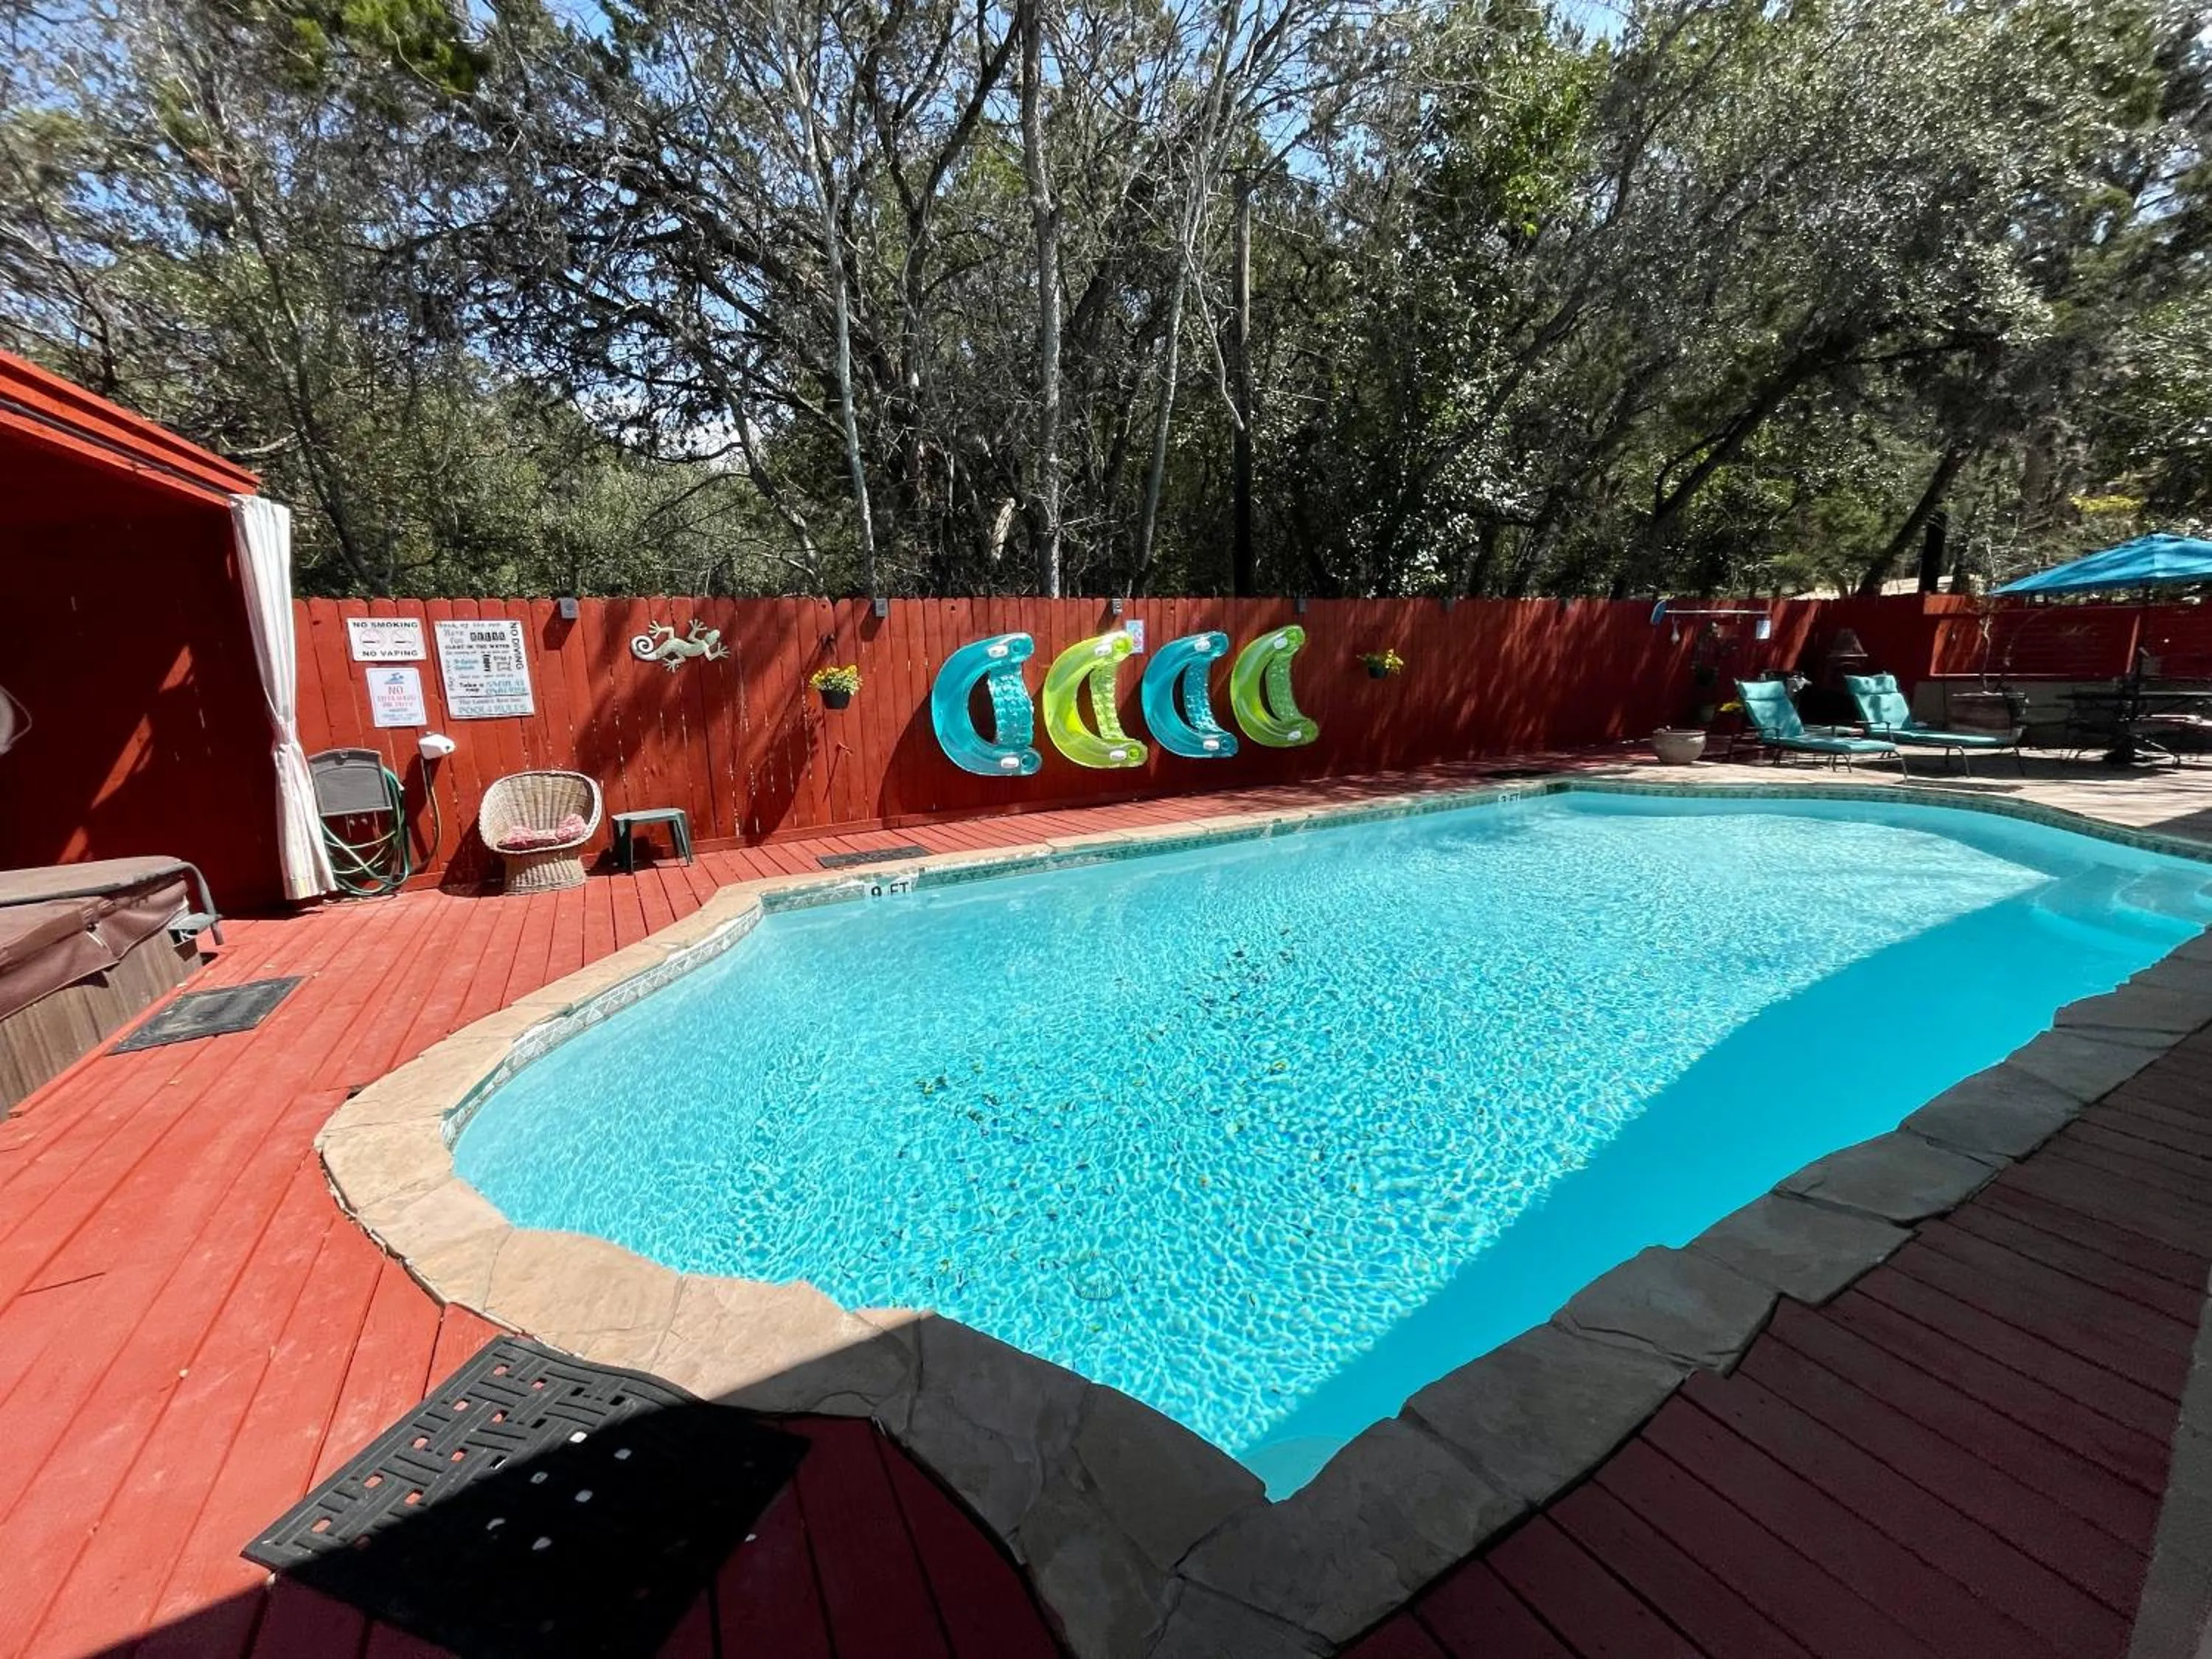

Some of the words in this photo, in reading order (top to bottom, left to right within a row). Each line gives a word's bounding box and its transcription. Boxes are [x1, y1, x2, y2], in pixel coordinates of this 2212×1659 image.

[509, 622, 518, 636] NO
[512, 638, 524, 670] DIVING
[389, 686, 403, 695] NO
